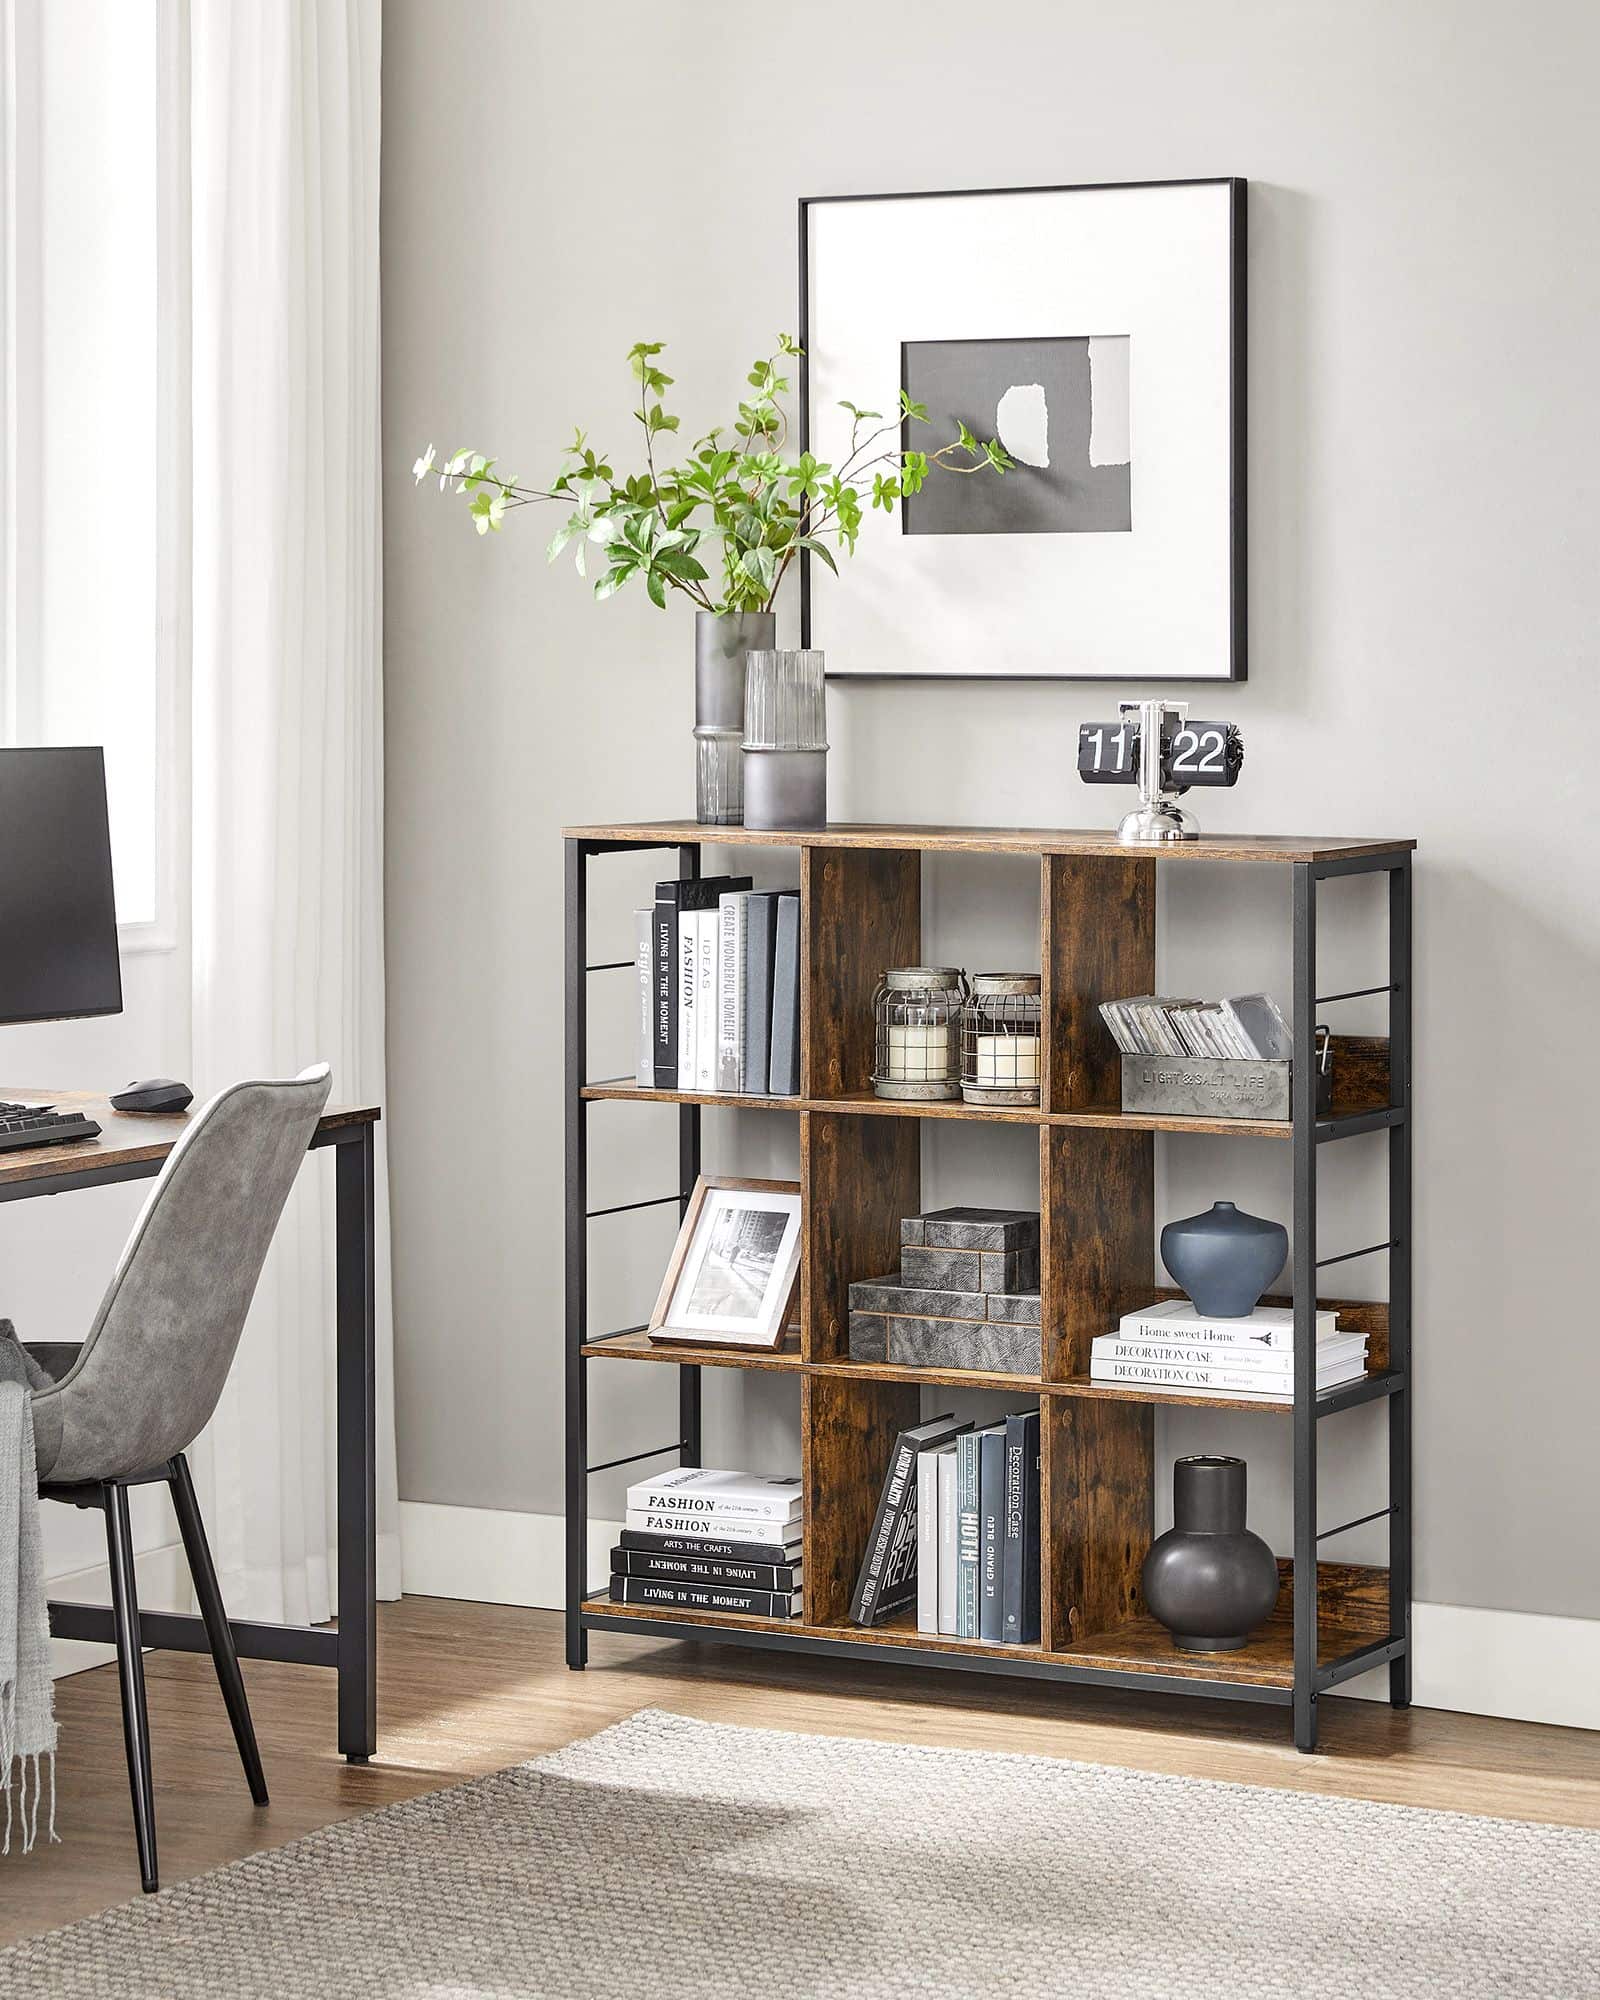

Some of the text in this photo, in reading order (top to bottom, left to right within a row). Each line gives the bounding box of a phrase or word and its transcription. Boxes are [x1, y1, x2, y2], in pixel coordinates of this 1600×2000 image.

[1087, 726, 1225, 772] 11 22
[637, 942, 650, 985] Style
[683, 936, 693, 1009] FASHION
[702, 939, 711, 989] IDEAS
[723, 905, 735, 1042] CREATE WONDERFUL HOMELIFE
[659, 923, 669, 1045] LIVING IN THE MOMENT
[1233, 1074, 1264, 1088] LIFE
[1139, 1324, 1236, 1342] Home sweet Home
[1115, 1345, 1213, 1363] DECORATION CASE
[1114, 1365, 1213, 1383] DECORATION CASE
[894, 1445, 914, 1480] ANDREW
[648, 1496, 715, 1511] FASHION
[886, 1476, 906, 1507] MARTIN
[1011, 1446, 1022, 1539] Decoration Case
[646, 1517, 711, 1533] FASHION
[960, 1512, 979, 1562] HOTH
[663, 1540, 733, 1554] ARTS THE CRAFTS
[986, 1516, 995, 1597] LE GRAND BLEU
[649, 1559, 756, 1580] LIVING IN THE MOMENT
[643, 1588, 751, 1608] LIVING IN THE MOMENT
